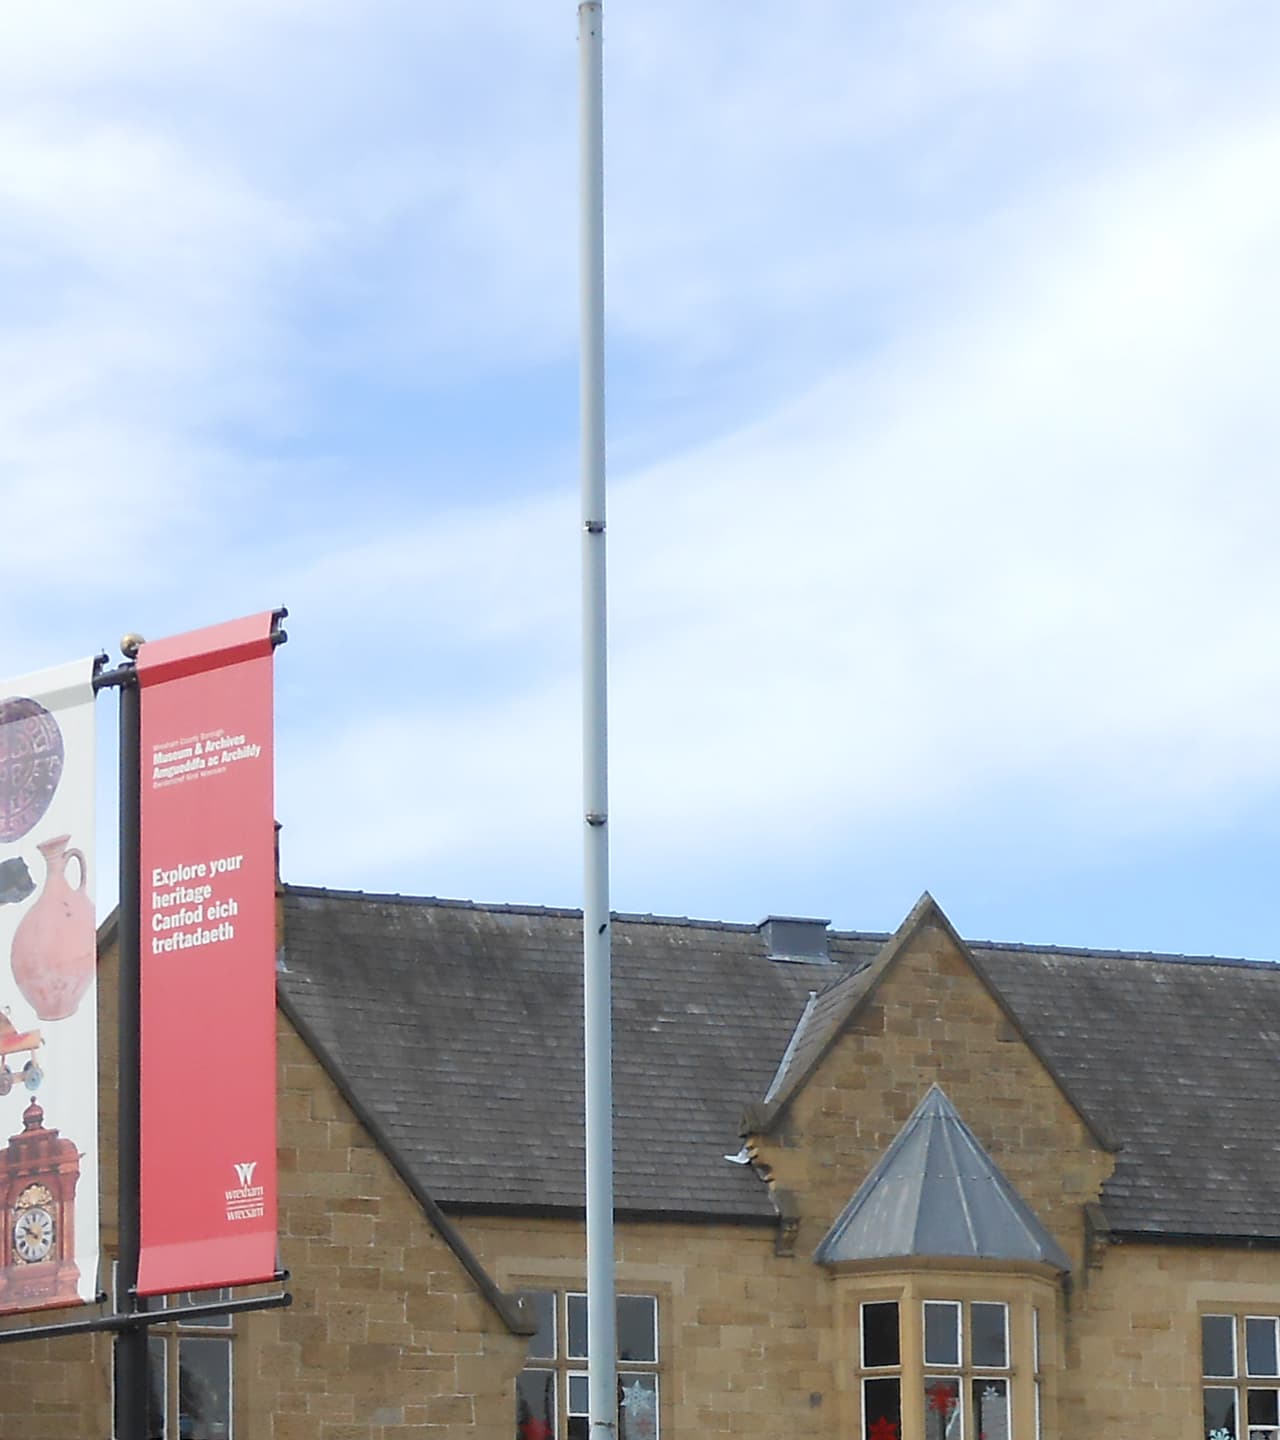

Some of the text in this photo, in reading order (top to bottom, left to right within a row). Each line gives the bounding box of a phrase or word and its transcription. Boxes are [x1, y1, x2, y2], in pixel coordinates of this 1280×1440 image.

[153, 735, 245, 765] Museum & Archives
[207, 756, 219, 766] ac
[221, 744, 261, 763] Archifdy
[152, 855, 244, 887] Explore your
[152, 884, 212, 910] heritage
[152, 898, 238, 931] Canfod eich
[152, 922, 234, 954] treftadaeth
